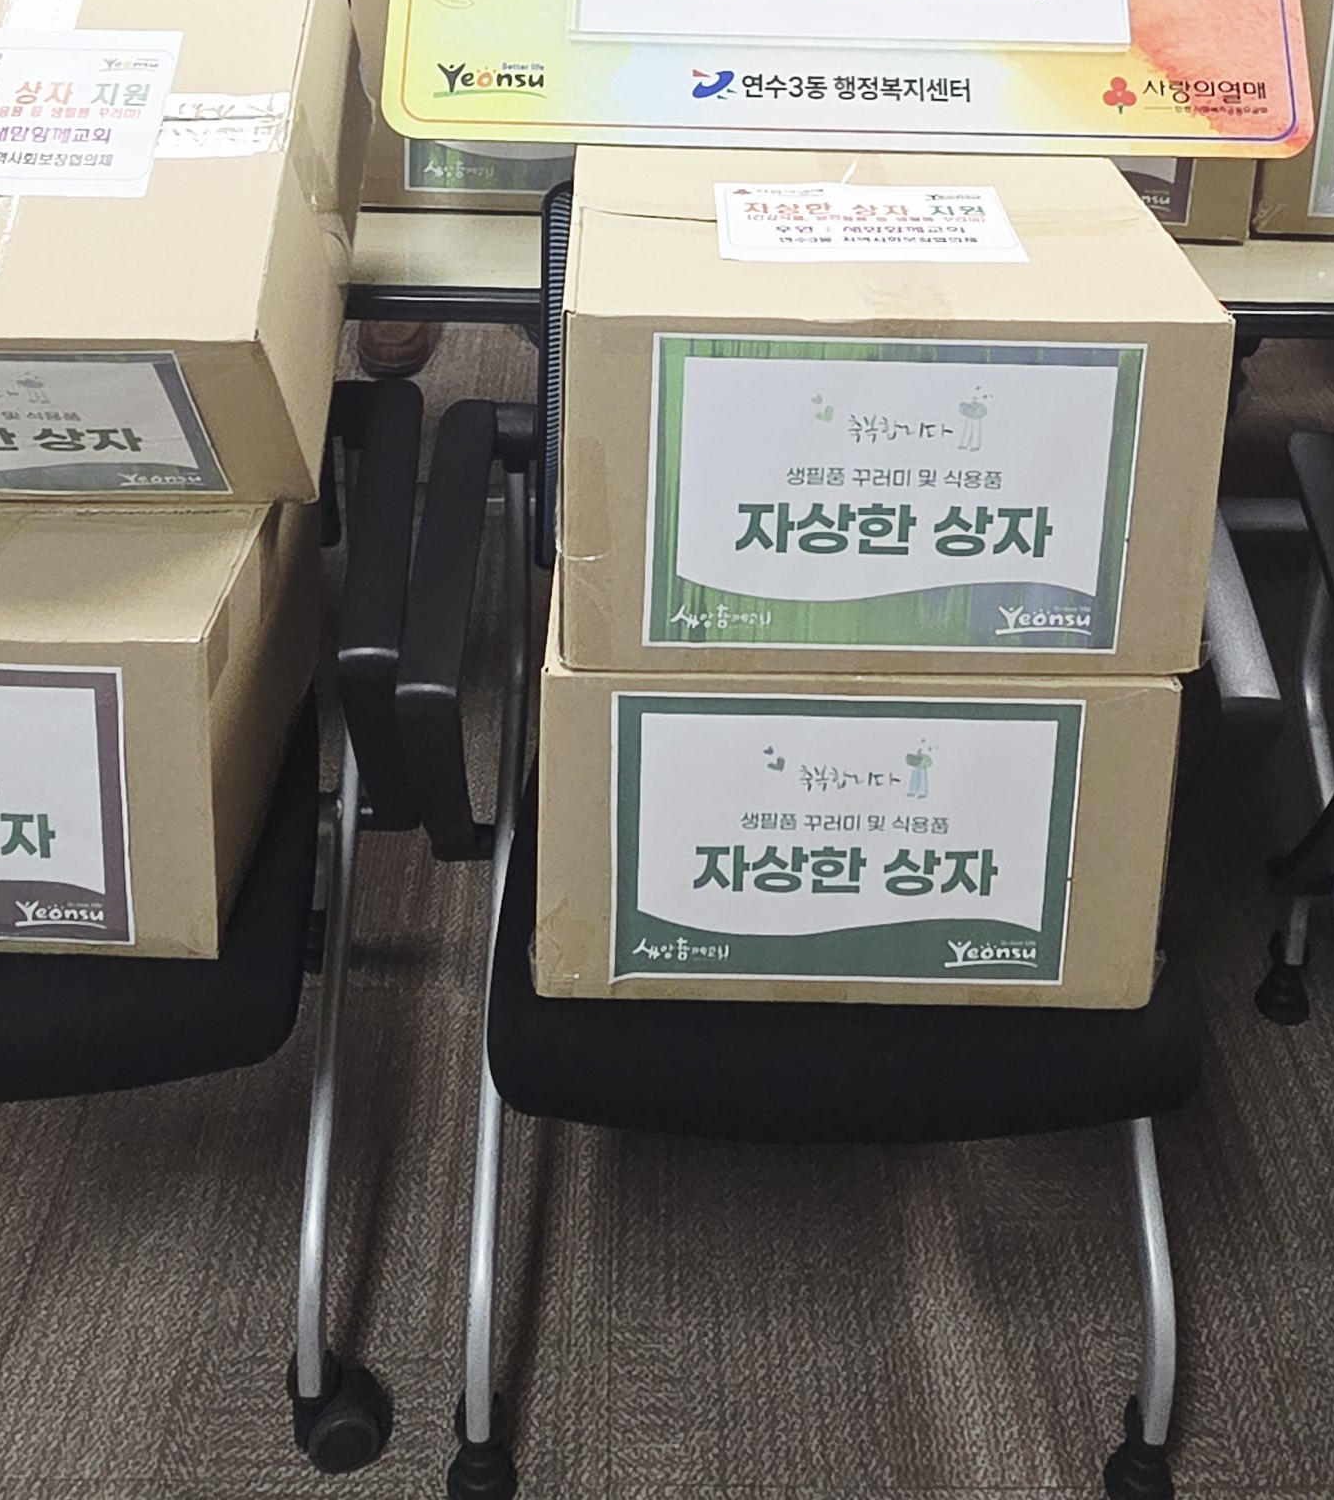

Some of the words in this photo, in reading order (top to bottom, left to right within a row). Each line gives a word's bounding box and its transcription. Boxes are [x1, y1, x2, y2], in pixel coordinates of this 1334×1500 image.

[437, 63, 544, 93] Yeonsu
[742, 74, 827, 100] 연수3동
[833, 75, 971, 102] 행정복지센터
[15, 82, 73, 105] 상자
[90, 83, 151, 106] 지원
[1143, 80, 1266, 104] 사랑의열매
[744, 203, 832, 215] 자상한
[852, 204, 908, 216] 상자
[34, 427, 143, 454] 상자
[785, 467, 845, 487] 생필품
[852, 468, 911, 488] 꾸러미
[918, 470, 936, 489] 및
[943, 470, 1002, 491] 식용품
[735, 502, 917, 554] 자상한
[934, 505, 1053, 558] 상자
[998, 607, 1091, 630] Yeonsu
[741, 812, 798, 831] 생필품
[804, 814, 861, 832] 꾸러미
[867, 815, 886, 833] 및
[891, 816, 949, 835] 식용품
[693, 845, 867, 894] 자상한
[883, 848, 998, 897] 상자
[16, 900, 104, 925] Yeonsu
[947, 941, 1036, 963] Yeonsu
